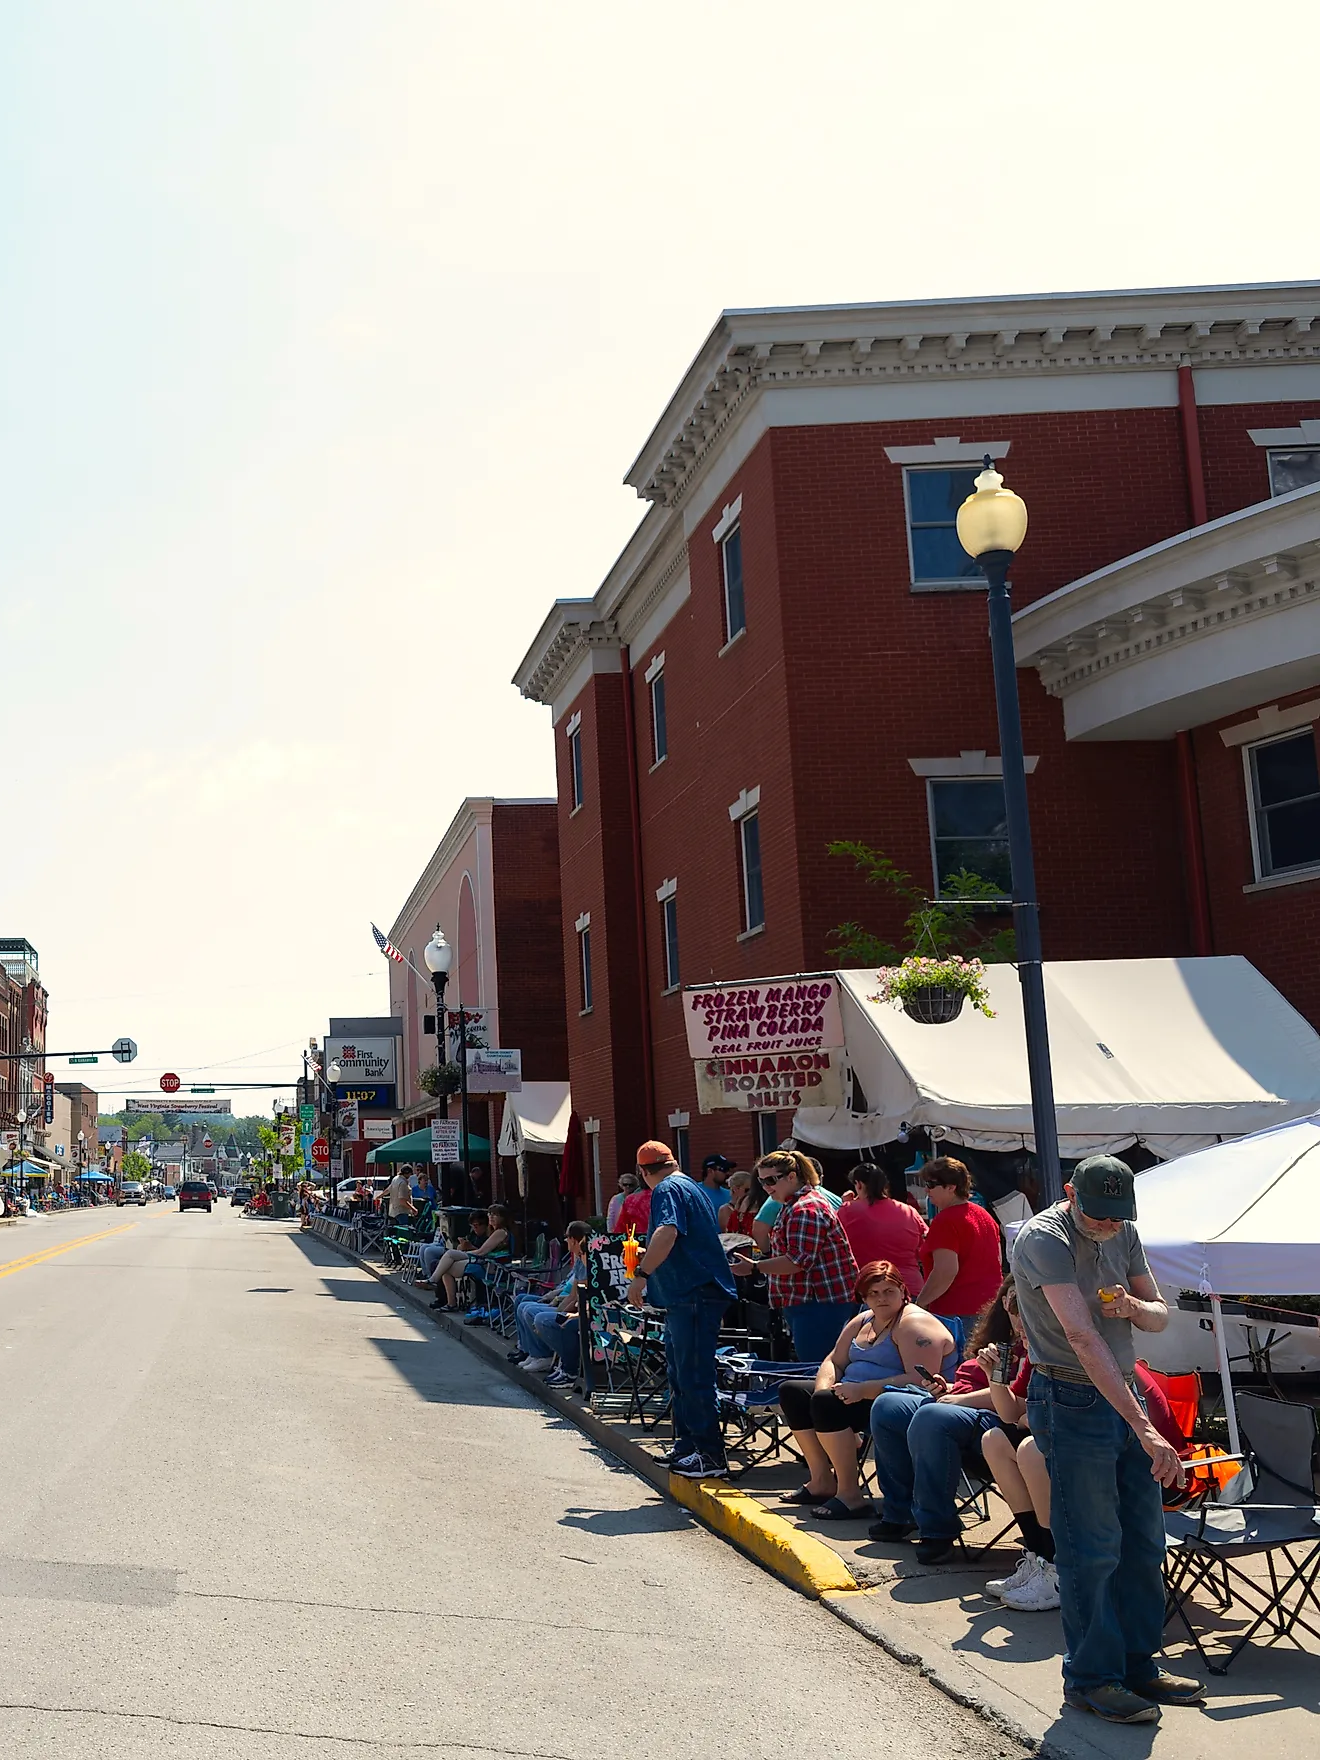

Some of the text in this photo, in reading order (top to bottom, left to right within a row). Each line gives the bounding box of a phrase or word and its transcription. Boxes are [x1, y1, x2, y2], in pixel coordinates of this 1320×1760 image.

[691, 982, 832, 1011] FROZEN MANGO
[703, 1000, 826, 1026] STRAWBERRY
[707, 1015, 824, 1041] PINA COLADA
[711, 1036, 823, 1054] REAL FRUIT JUICE
[331, 1056, 389, 1071] Community
[357, 1050, 373, 1059] First
[365, 1068, 384, 1077] Bank
[706, 1054, 830, 1077] CINNAMON
[161, 1079, 179, 1088] STOP
[724, 1071, 822, 1093] ROASTED
[346, 1091, 376, 1101] 11:07
[746, 1090, 802, 1109] NUTS
[312, 1145, 329, 1156] STO
